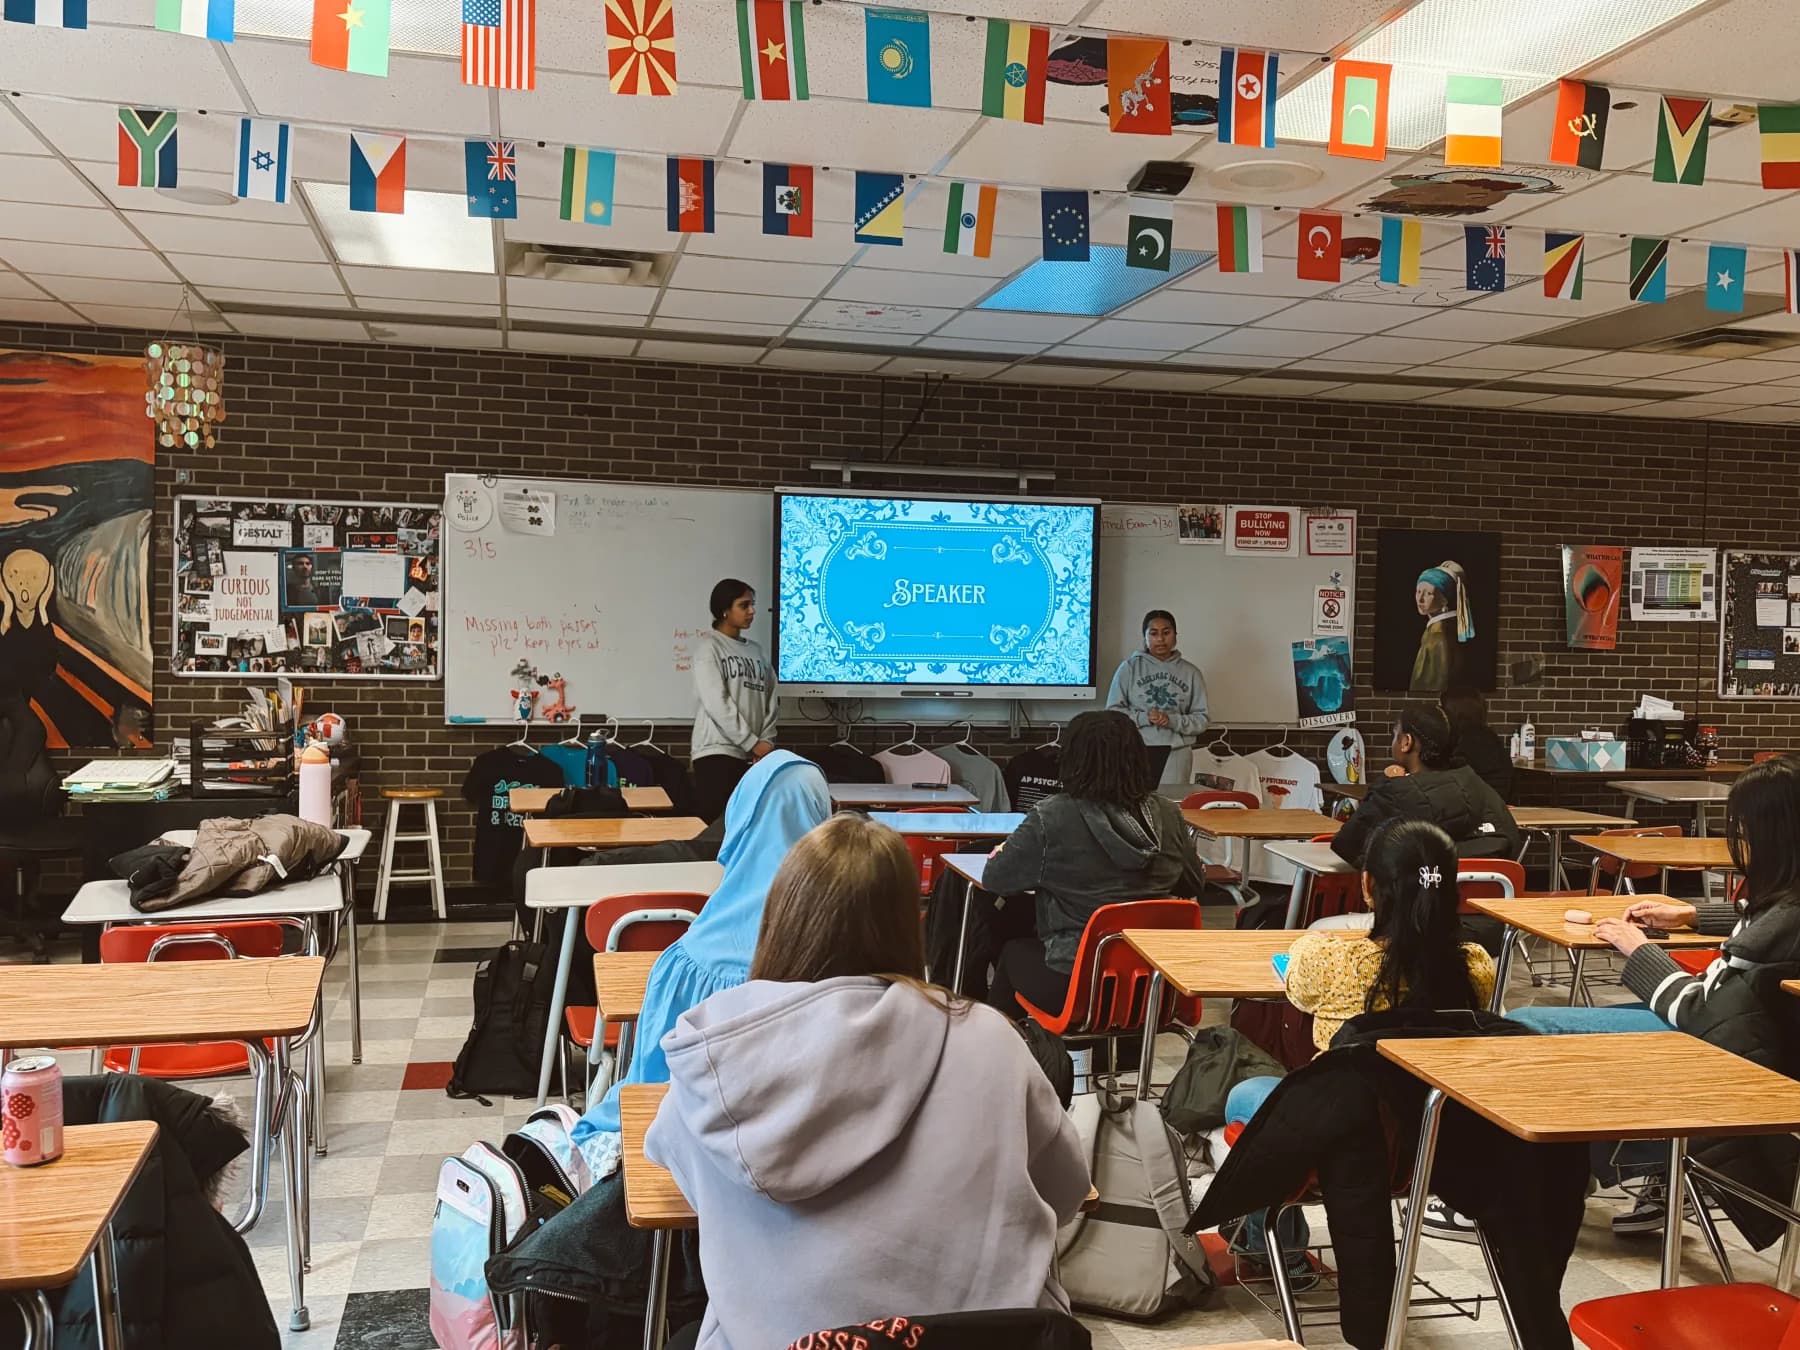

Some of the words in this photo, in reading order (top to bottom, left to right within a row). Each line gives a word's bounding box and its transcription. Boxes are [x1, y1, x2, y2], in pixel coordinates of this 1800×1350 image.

[1241, 520, 1285, 529] BULLYING
[239, 528, 283, 538] GESTALT
[240, 565, 248, 576] BE
[221, 579, 270, 595] CURIOUS
[883, 578, 986, 608] SPEAKER
[1320, 590, 1345, 598] NOTICE
[236, 597, 252, 608] NOT
[214, 608, 273, 621] JUDGEMENTAL
[465, 616, 519, 642] Missing
[525, 615, 552, 631] both
[721, 655, 757, 681] OCEAN
[1302, 711, 1356, 728] DISCOVERY
[1021, 776, 1032, 784] AP
